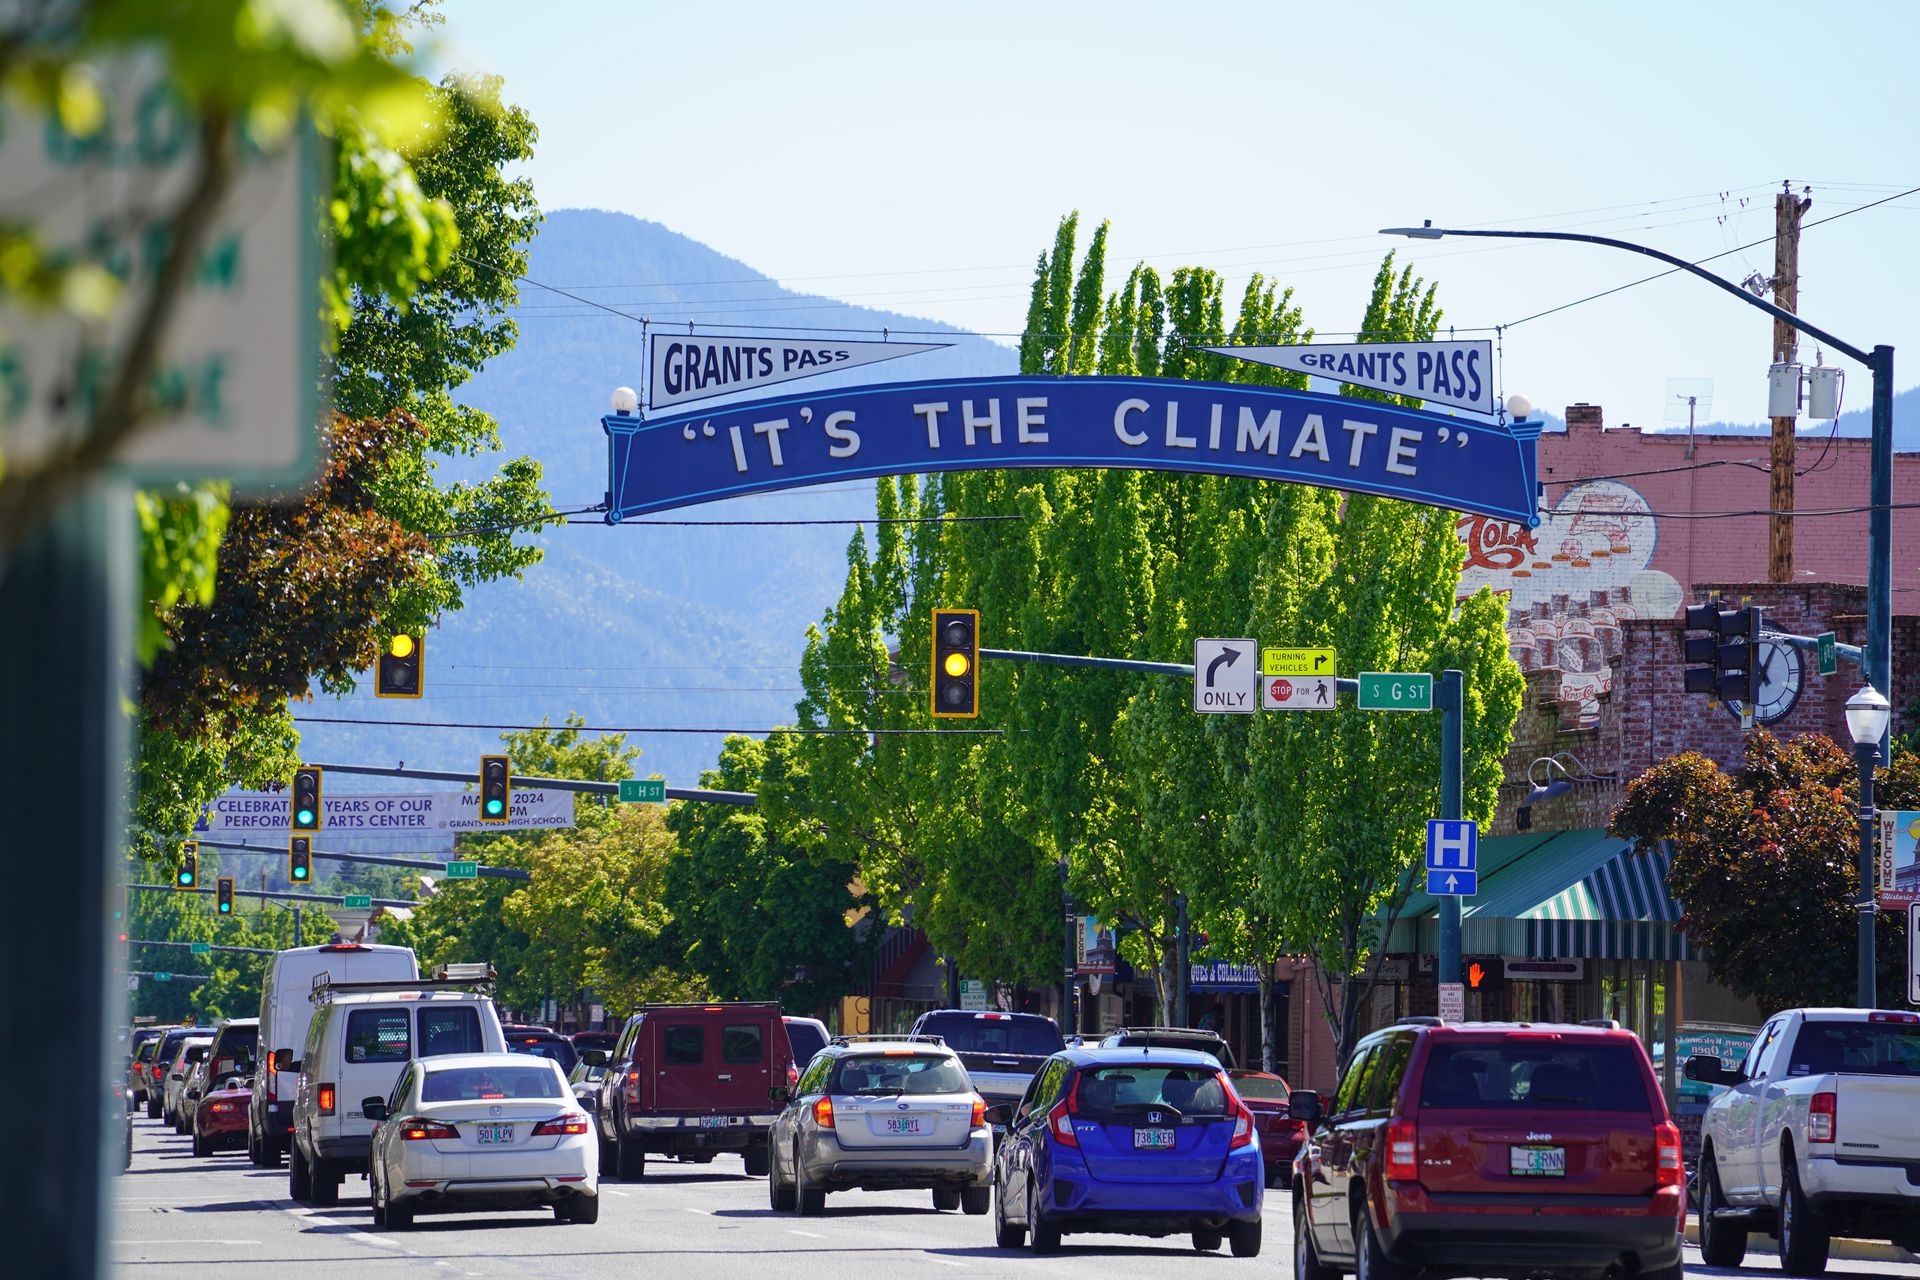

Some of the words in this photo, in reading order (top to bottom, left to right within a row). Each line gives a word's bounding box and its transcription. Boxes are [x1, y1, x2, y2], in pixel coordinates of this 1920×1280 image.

[663, 342, 773, 395] GRANTS
[783, 348, 850, 372] PASS
[1300, 351, 1406, 386] GRANTS
[1418, 350, 1481, 402] PASS
[913, 397, 1049, 448] THE
[1271, 653, 1306, 661] TURNING
[1270, 664, 1308, 672] VEHICLES
[1271, 686, 1293, 695] STOP
[1296, 688, 1310, 696] FOR
[1373, 686, 1380, 698] S
[1391, 683, 1402, 700] G
[1408, 685, 1425, 699] ST
[1204, 692, 1247, 706] ONLY
[627, 787, 632, 796] S
[638, 786, 646, 797] H
[650, 788, 660, 796] ST
[462, 796, 480, 806] MA
[514, 793, 544, 804] 2024
[325, 801, 370, 812] YEARS
[375, 800, 395, 812] OF
[400, 800, 432, 811] OUR
[225, 815, 291, 827] PERFORM
[328, 815, 364, 827] ARTS
[369, 815, 425, 827] CENTER
[449, 820, 483, 828] GRANTS
[508, 818, 529, 826] HIGH
[532, 816, 567, 825] SCHOOL
[1434, 823, 1469, 867] H
[1883, 821, 1894, 888] WELCOME
[1882, 892, 1913, 901] Historic
[1191, 964, 1208, 984] QUES
[887, 1119, 901, 1129] 583
[480, 1129, 493, 1139] 501
[498, 1129, 512, 1139] LPV
[1135, 1133, 1151, 1144] 738
[1157, 1133, 1173, 1144] KER
[1526, 1132, 1552, 1142] Jeep
